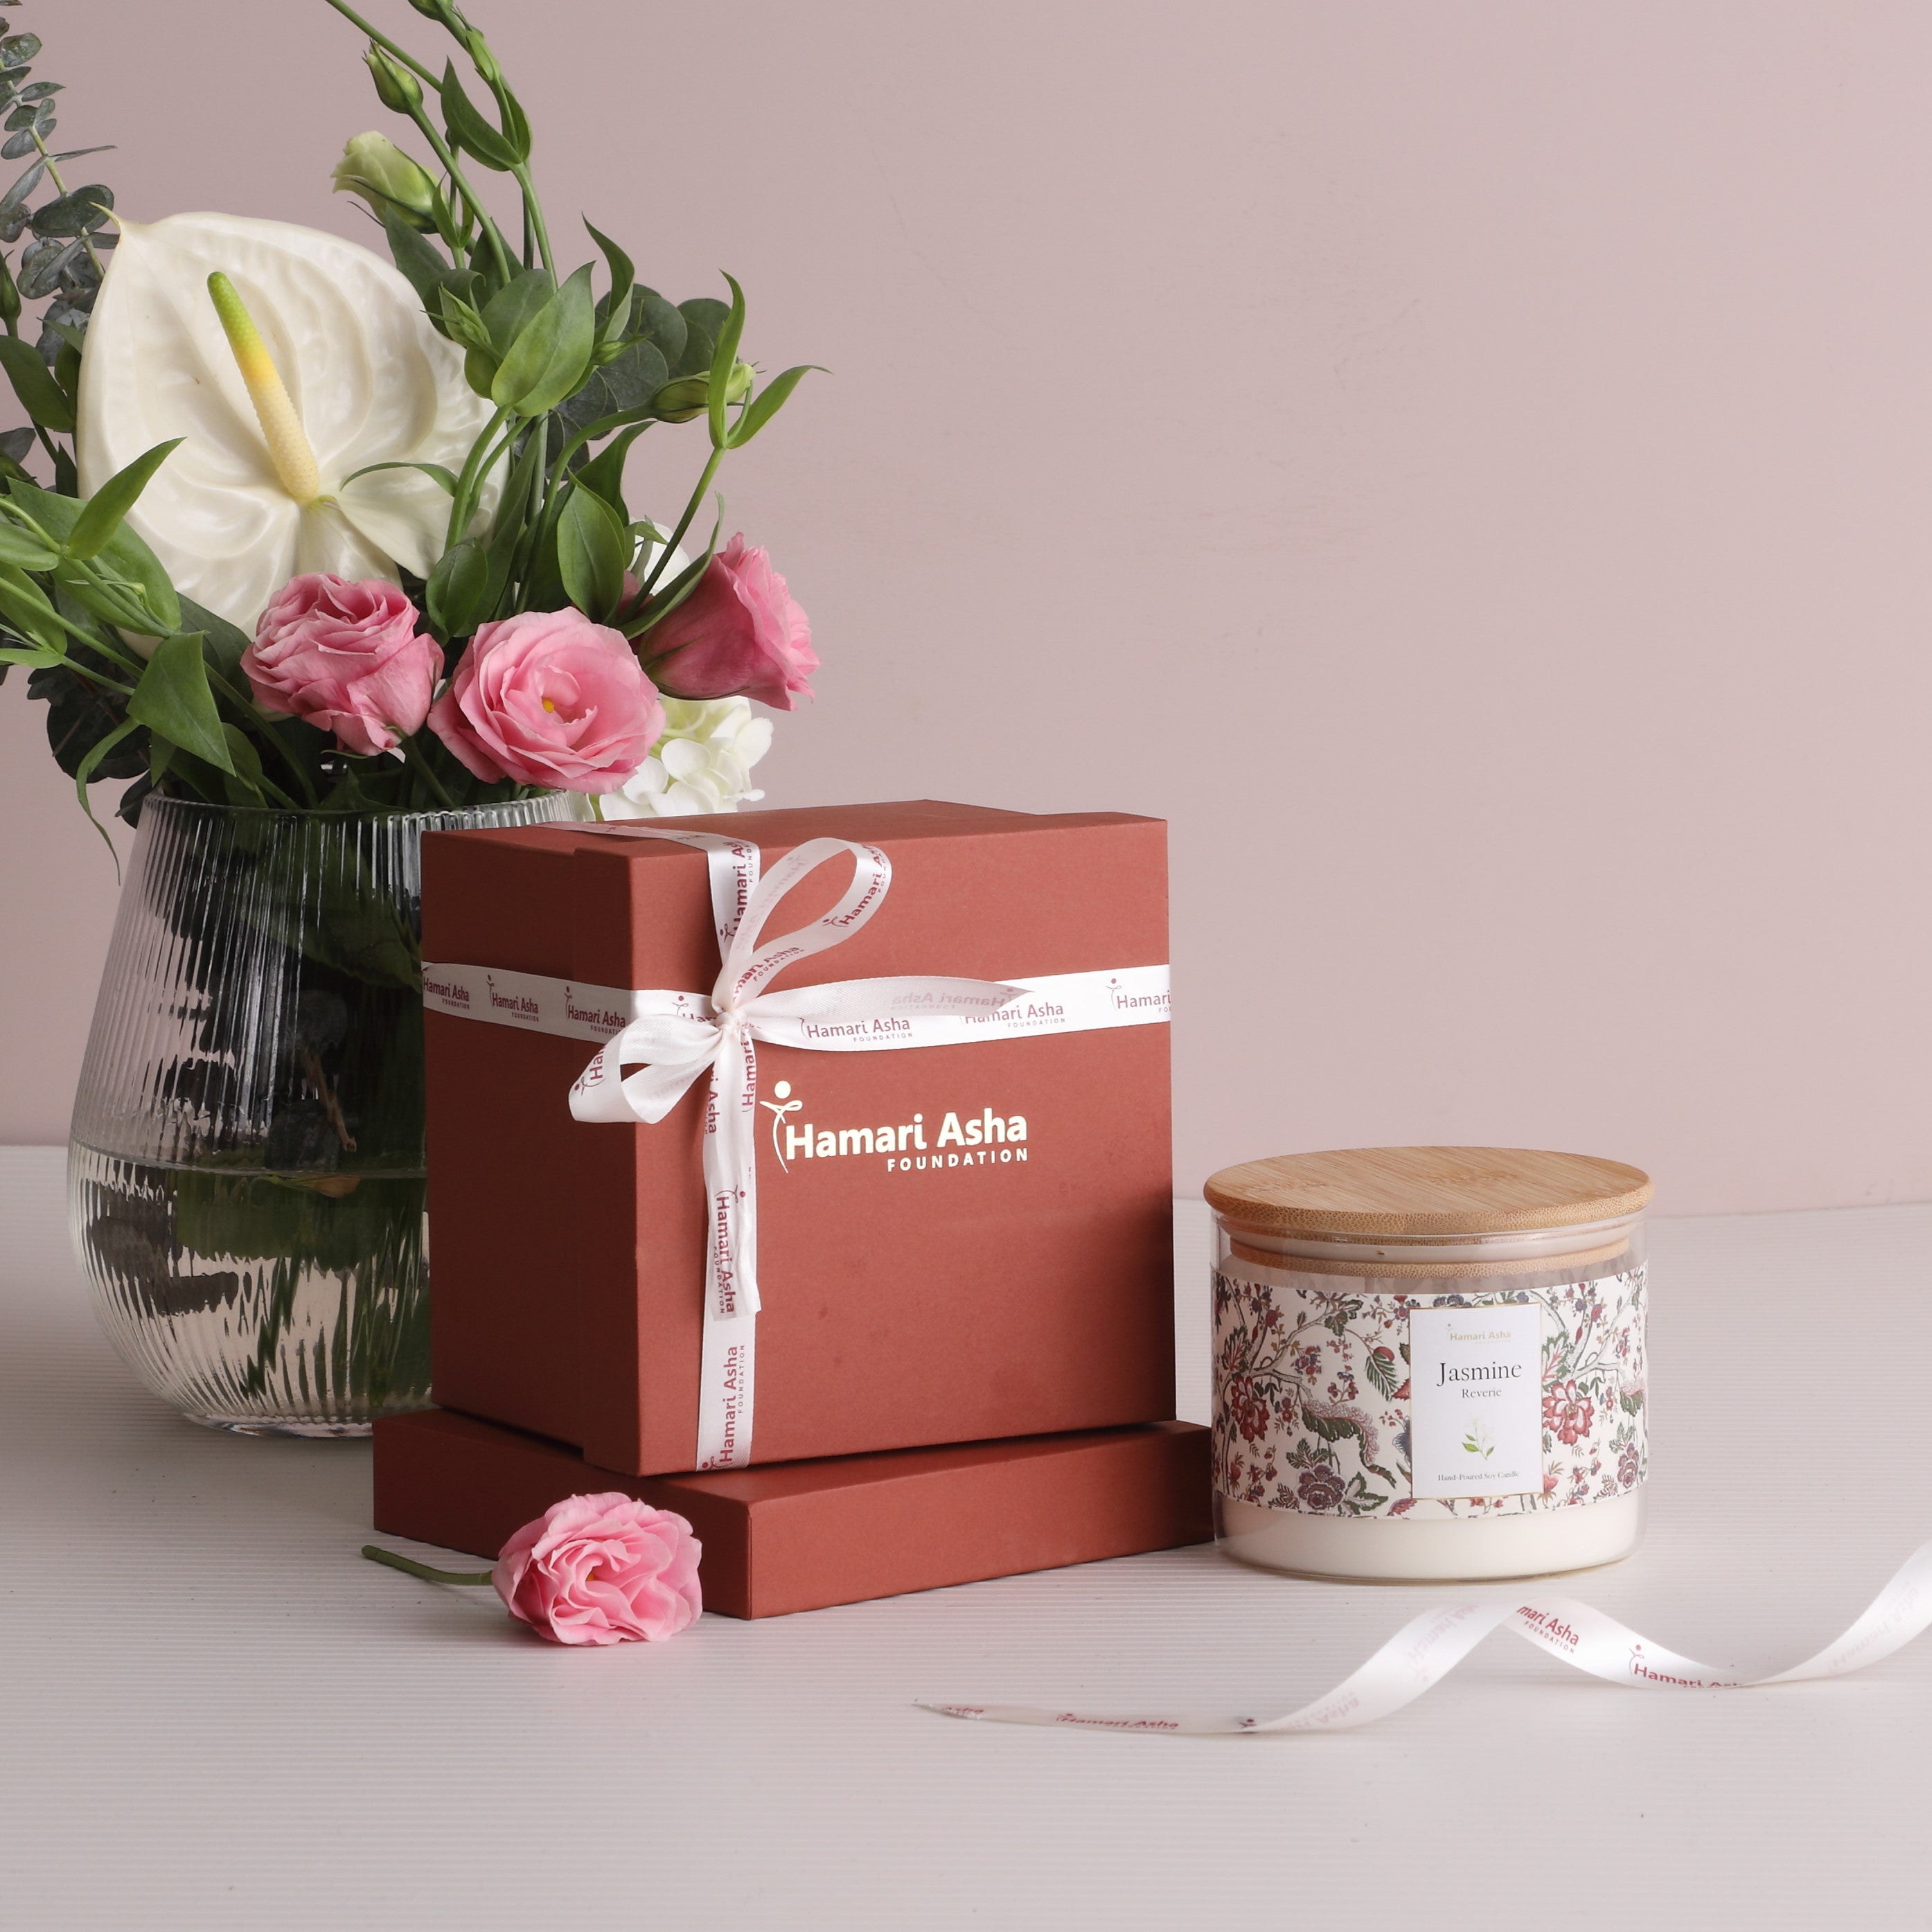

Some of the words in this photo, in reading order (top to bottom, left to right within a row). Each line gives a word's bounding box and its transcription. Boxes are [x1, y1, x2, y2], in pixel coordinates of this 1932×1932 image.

[839, 873, 883, 925] Hamari
[423, 977, 451, 997] Hamari
[452, 984, 470, 1002] Asha
[1116, 989, 1171, 1009] Hamari
[492, 992, 519, 1011] Hamari
[520, 998, 539, 1014] Asha
[568, 1004, 601, 1024] Hamari
[602, 1011, 626, 1028] Asha
[1027, 1002, 1064, 1018] Asha
[511, 1011, 539, 1022] FOUNDATION
[807, 1020, 868, 1038] Hamari
[872, 1017, 911, 1033] Asha
[1007, 1018, 1065, 1028] FOUNDATION
[853, 1031, 913, 1042] FOUNDATION
[741, 1038, 756, 1106] Hamari
[708, 1090, 720, 1133] Asha
[786, 1113, 927, 1160] Hamari
[937, 1107, 1027, 1149] Asha
[887, 1146, 1029, 1173] FOUNDATION
[716, 1196, 733, 1266] Hamari
[714, 1246, 725, 1313] FOUNDATION
[721, 1270, 736, 1313] Asha
[1450, 1331, 1486, 1341] Hamari
[1488, 1330, 1512, 1340] Asha
[723, 1346, 738, 1390] Asha
[1437, 1361, 1522, 1387] Jasmine
[1462, 1388, 1502, 1399] Reverie
[719, 1395, 737, 1463] Hamari
[1516, 1606, 1550, 1625] mari
[1545, 1618, 1579, 1646] Asha
[1524, 1621, 1575, 1654] FOUNDATION
[1633, 1663, 1703, 1687] Hamari
